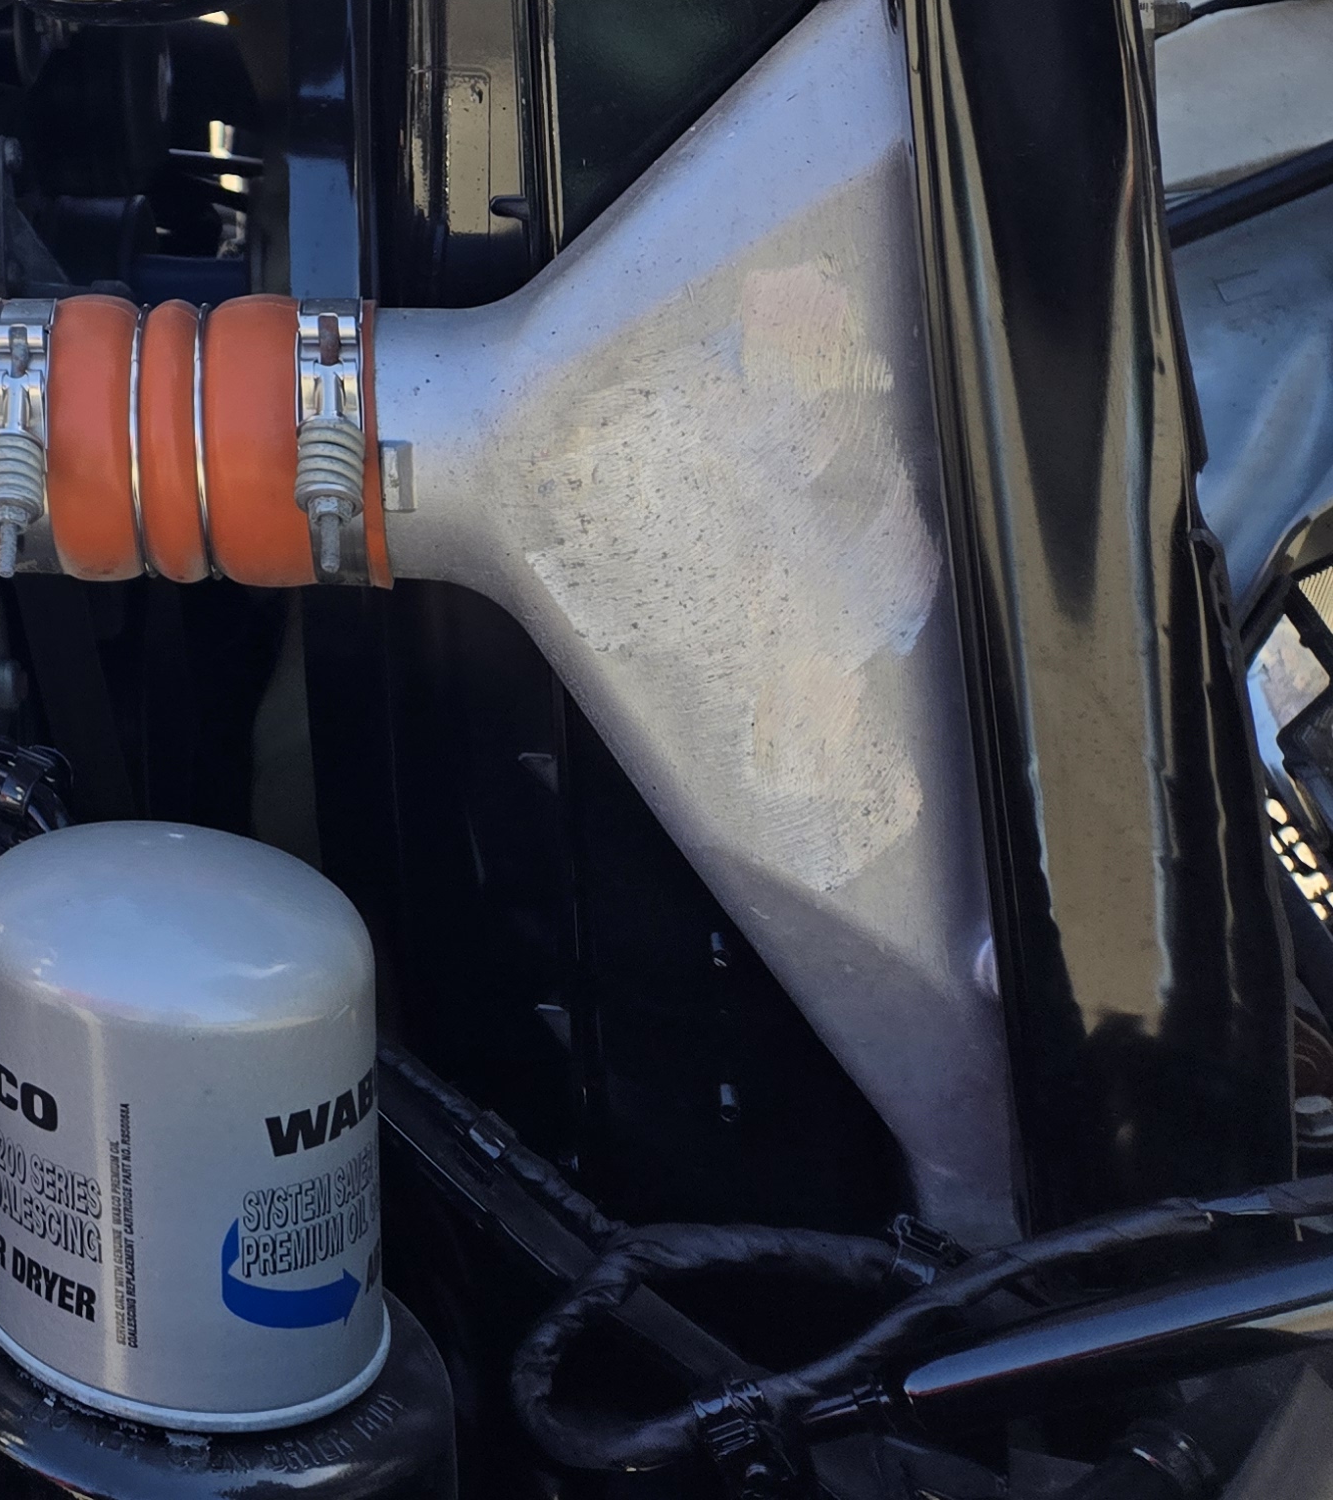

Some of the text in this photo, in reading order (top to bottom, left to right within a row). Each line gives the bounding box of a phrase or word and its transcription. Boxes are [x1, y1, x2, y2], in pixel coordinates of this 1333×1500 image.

[265, 1067, 374, 1157] WAB
[110, 1154, 121, 1195] PREMIUM
[121, 1145, 131, 1162] NO.
[121, 1162, 132, 1186] PART
[30, 1153, 102, 1220] SERIES
[111, 1195, 122, 1226] WABCO
[122, 1186, 134, 1235] CARTRIDGE
[242, 1173, 331, 1233] SYSTEM
[242, 1212, 344, 1278] PREMIUM
[347, 1195, 368, 1244] OIL
[12, 1246, 96, 1323] DRYER
[114, 1265, 124, 1287] WITH
[124, 1237, 136, 1297] REPLACEMENT
[114, 1288, 125, 1311] ONLY
[126, 1297, 138, 1348] COALESCING
[115, 1311, 126, 1346] SERVICE
